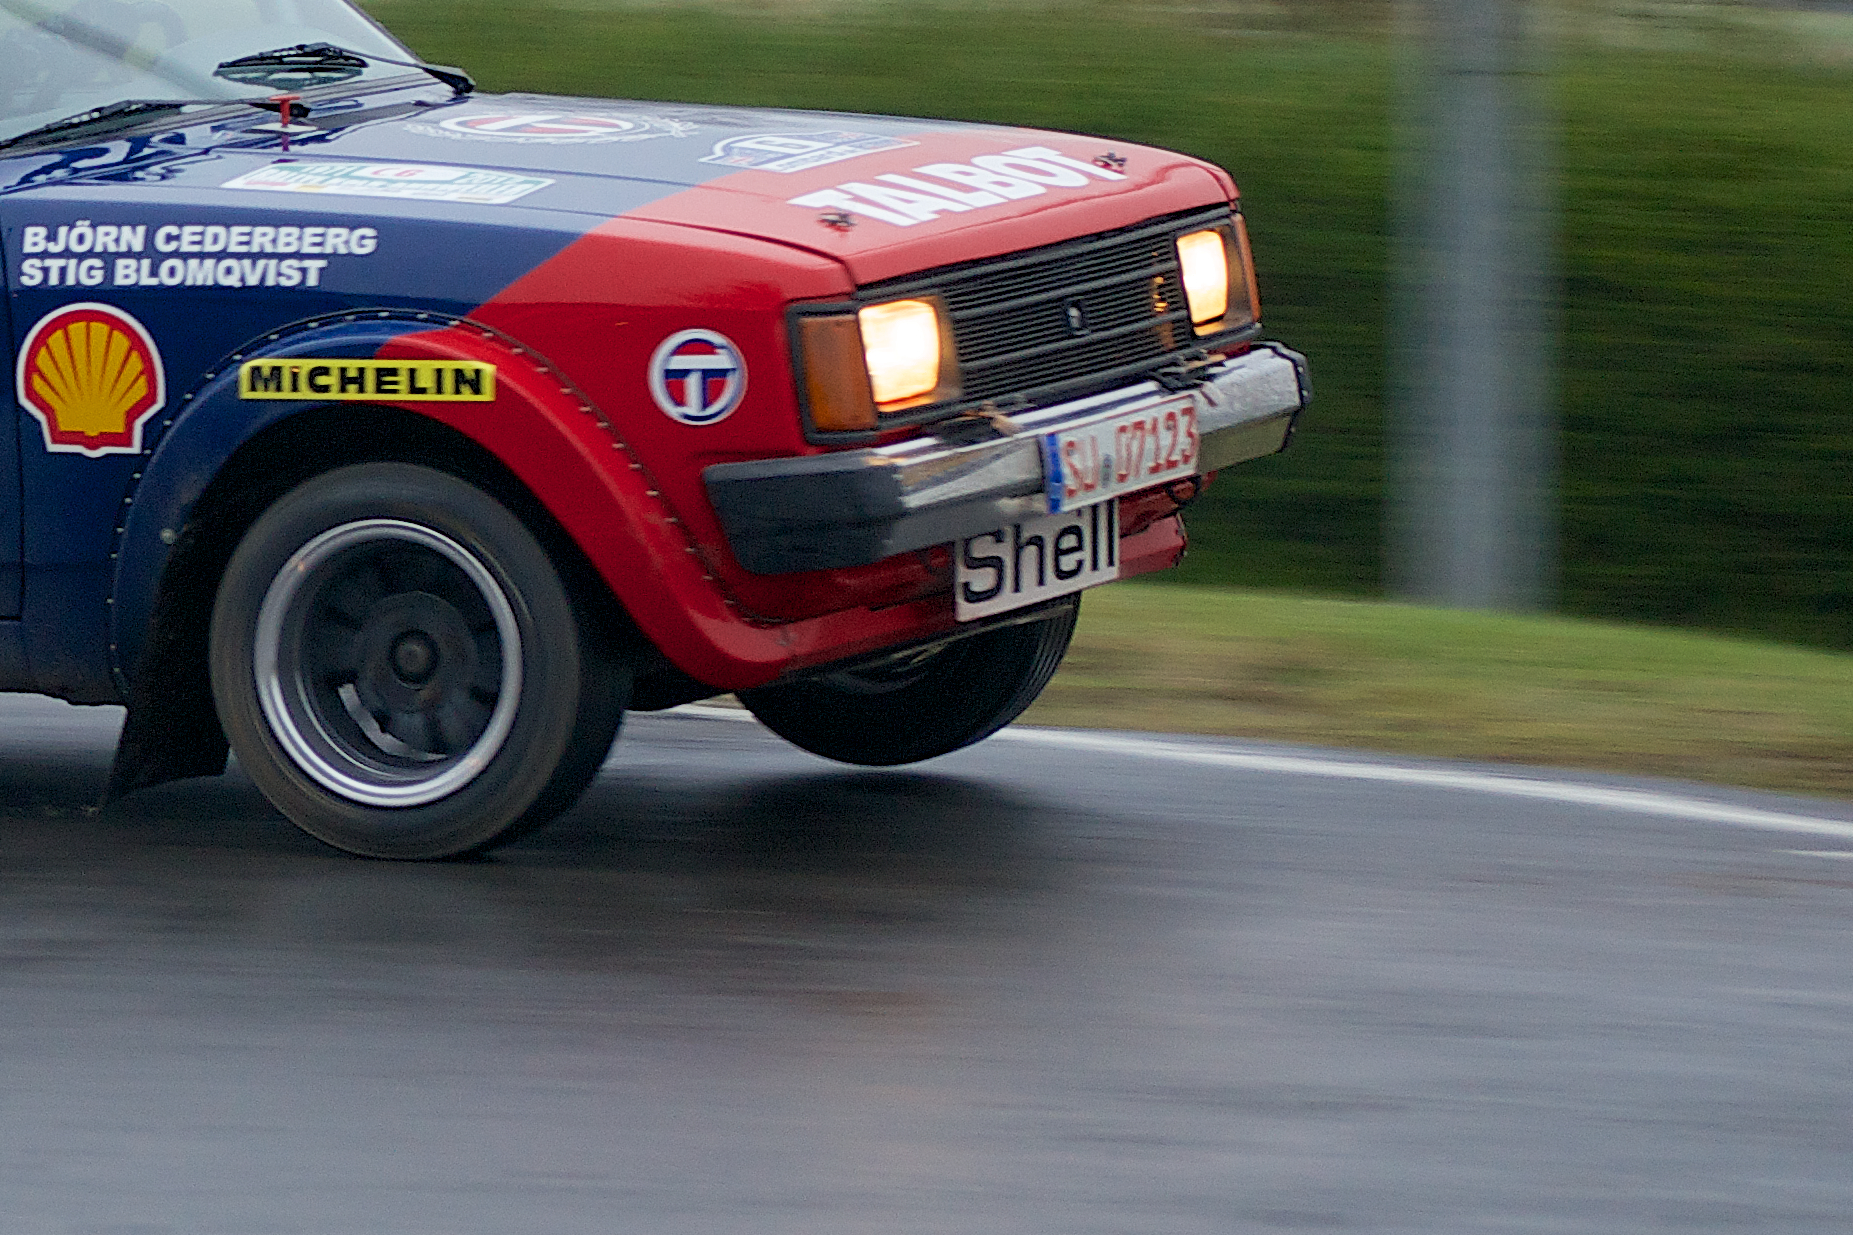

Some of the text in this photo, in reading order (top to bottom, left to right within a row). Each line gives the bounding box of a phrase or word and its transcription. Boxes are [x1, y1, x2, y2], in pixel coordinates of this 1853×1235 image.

[786, 145, 1129, 227] TALBOT
[22, 220, 147, 253] BJÖRN
[153, 225, 379, 255] CEDERBERG
[20, 258, 105, 287] STIG
[113, 258, 328, 288] BLOMQVIST
[249, 365, 483, 397] MICHELIN
[1114, 405, 1198, 484] 07123
[962, 497, 1117, 604] Shell
